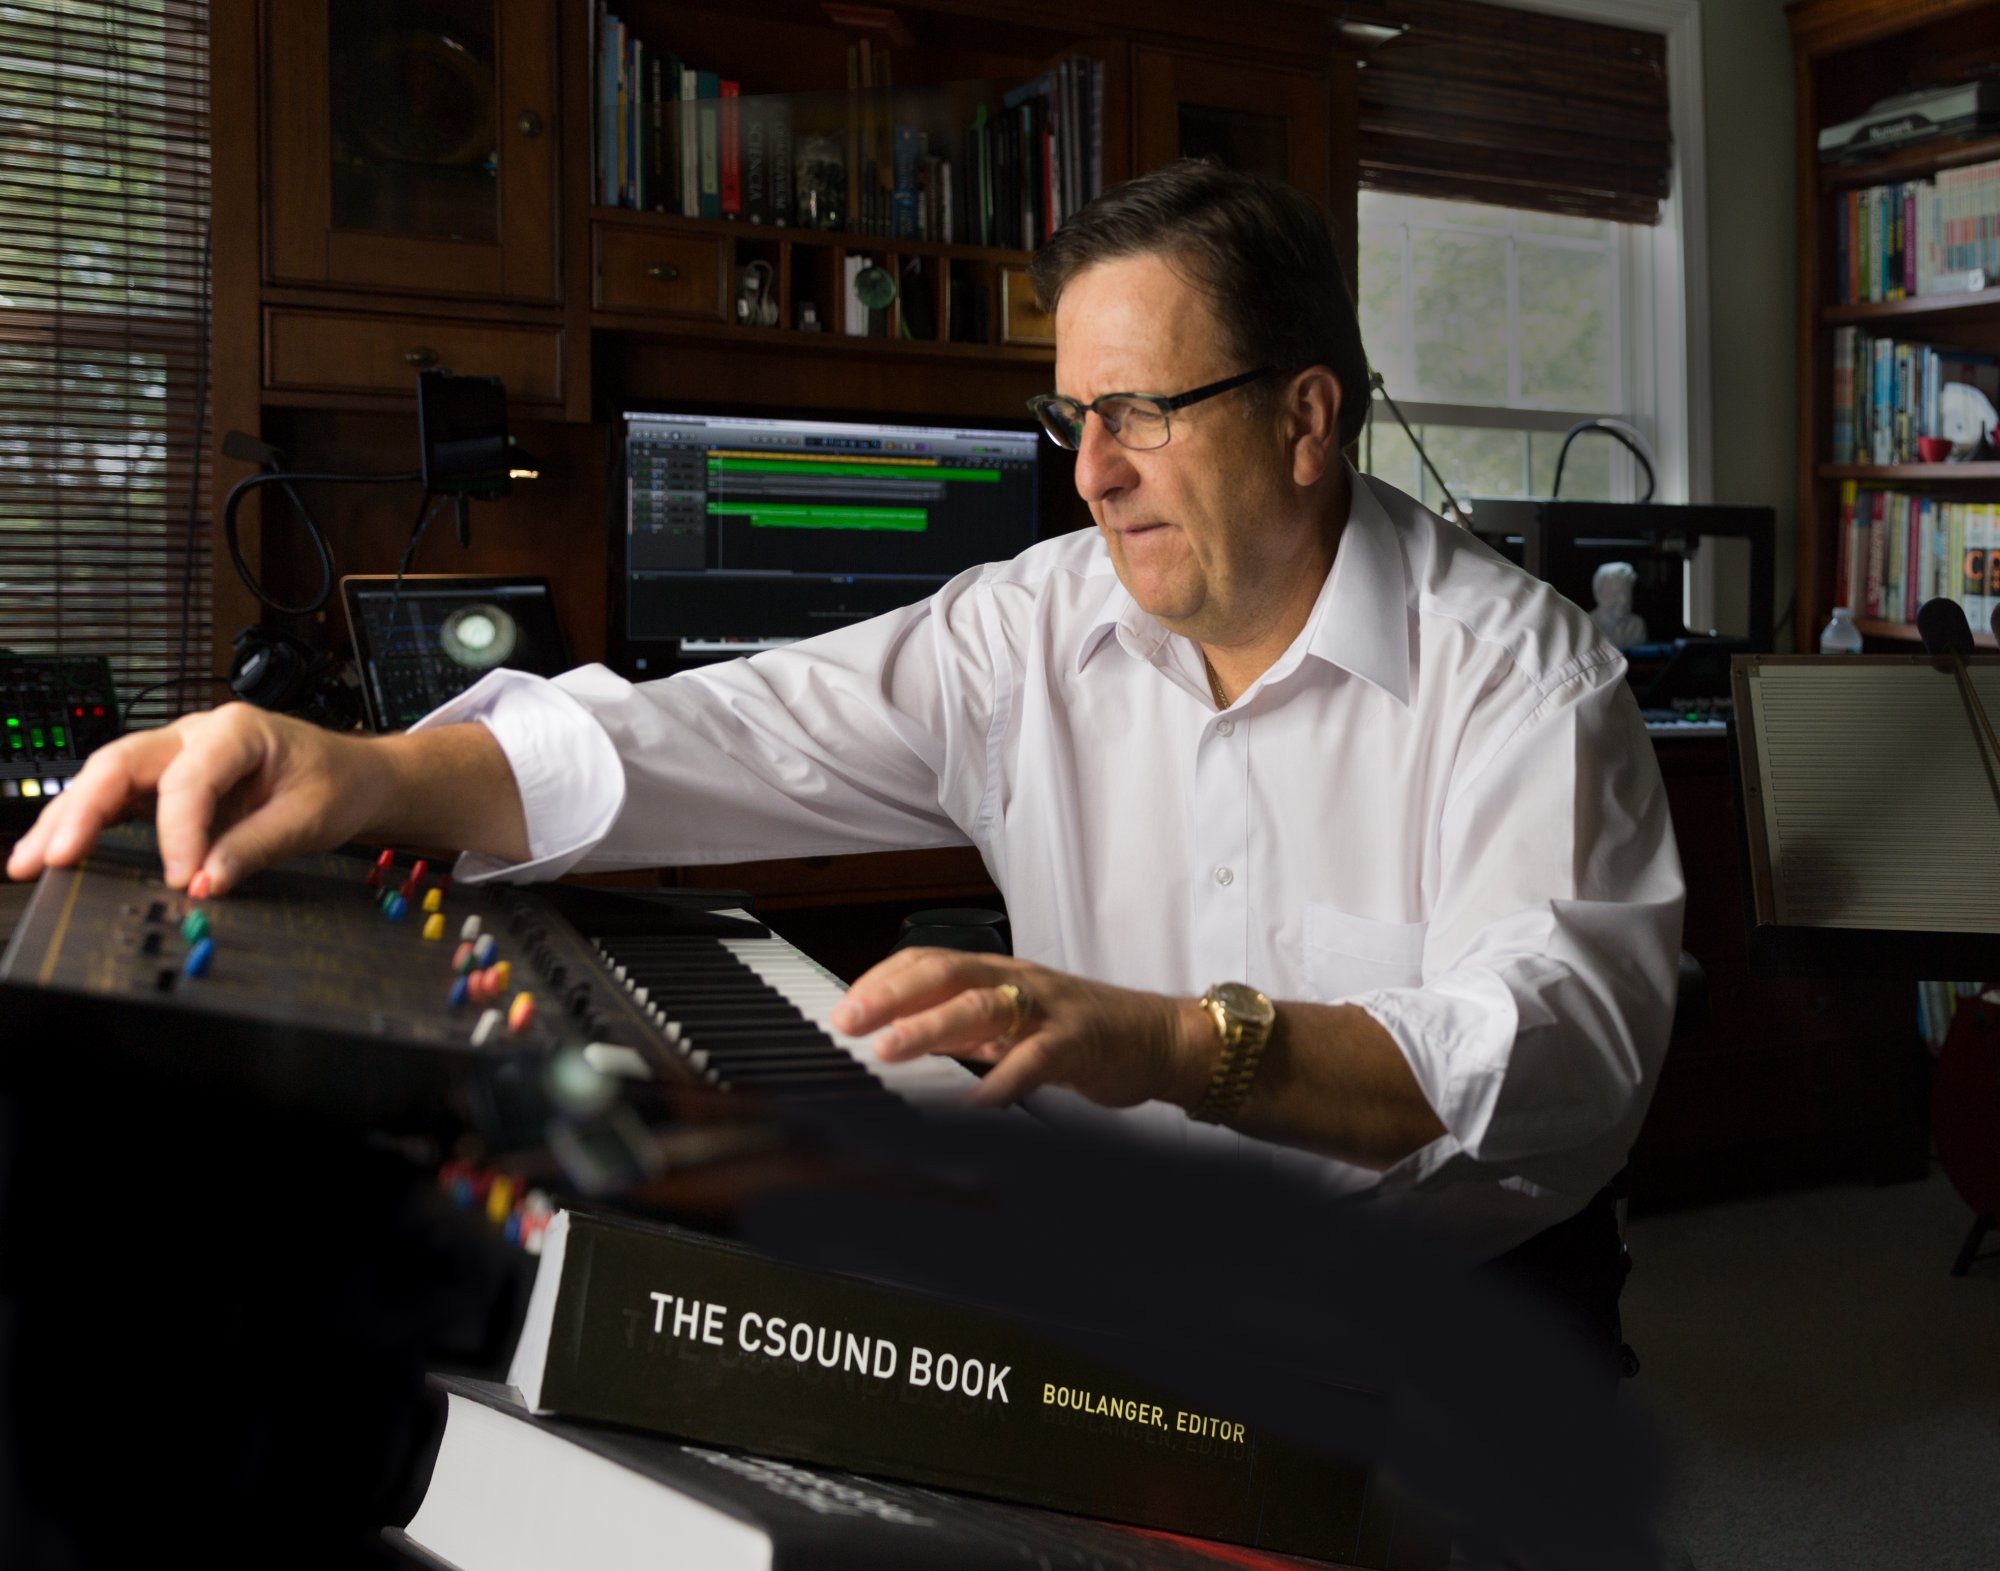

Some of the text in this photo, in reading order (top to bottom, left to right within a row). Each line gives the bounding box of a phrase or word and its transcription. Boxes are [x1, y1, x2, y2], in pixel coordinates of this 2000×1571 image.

[649, 1290, 1246, 1445] THE CSOUND BOOK BOULANGER, EDITOR
